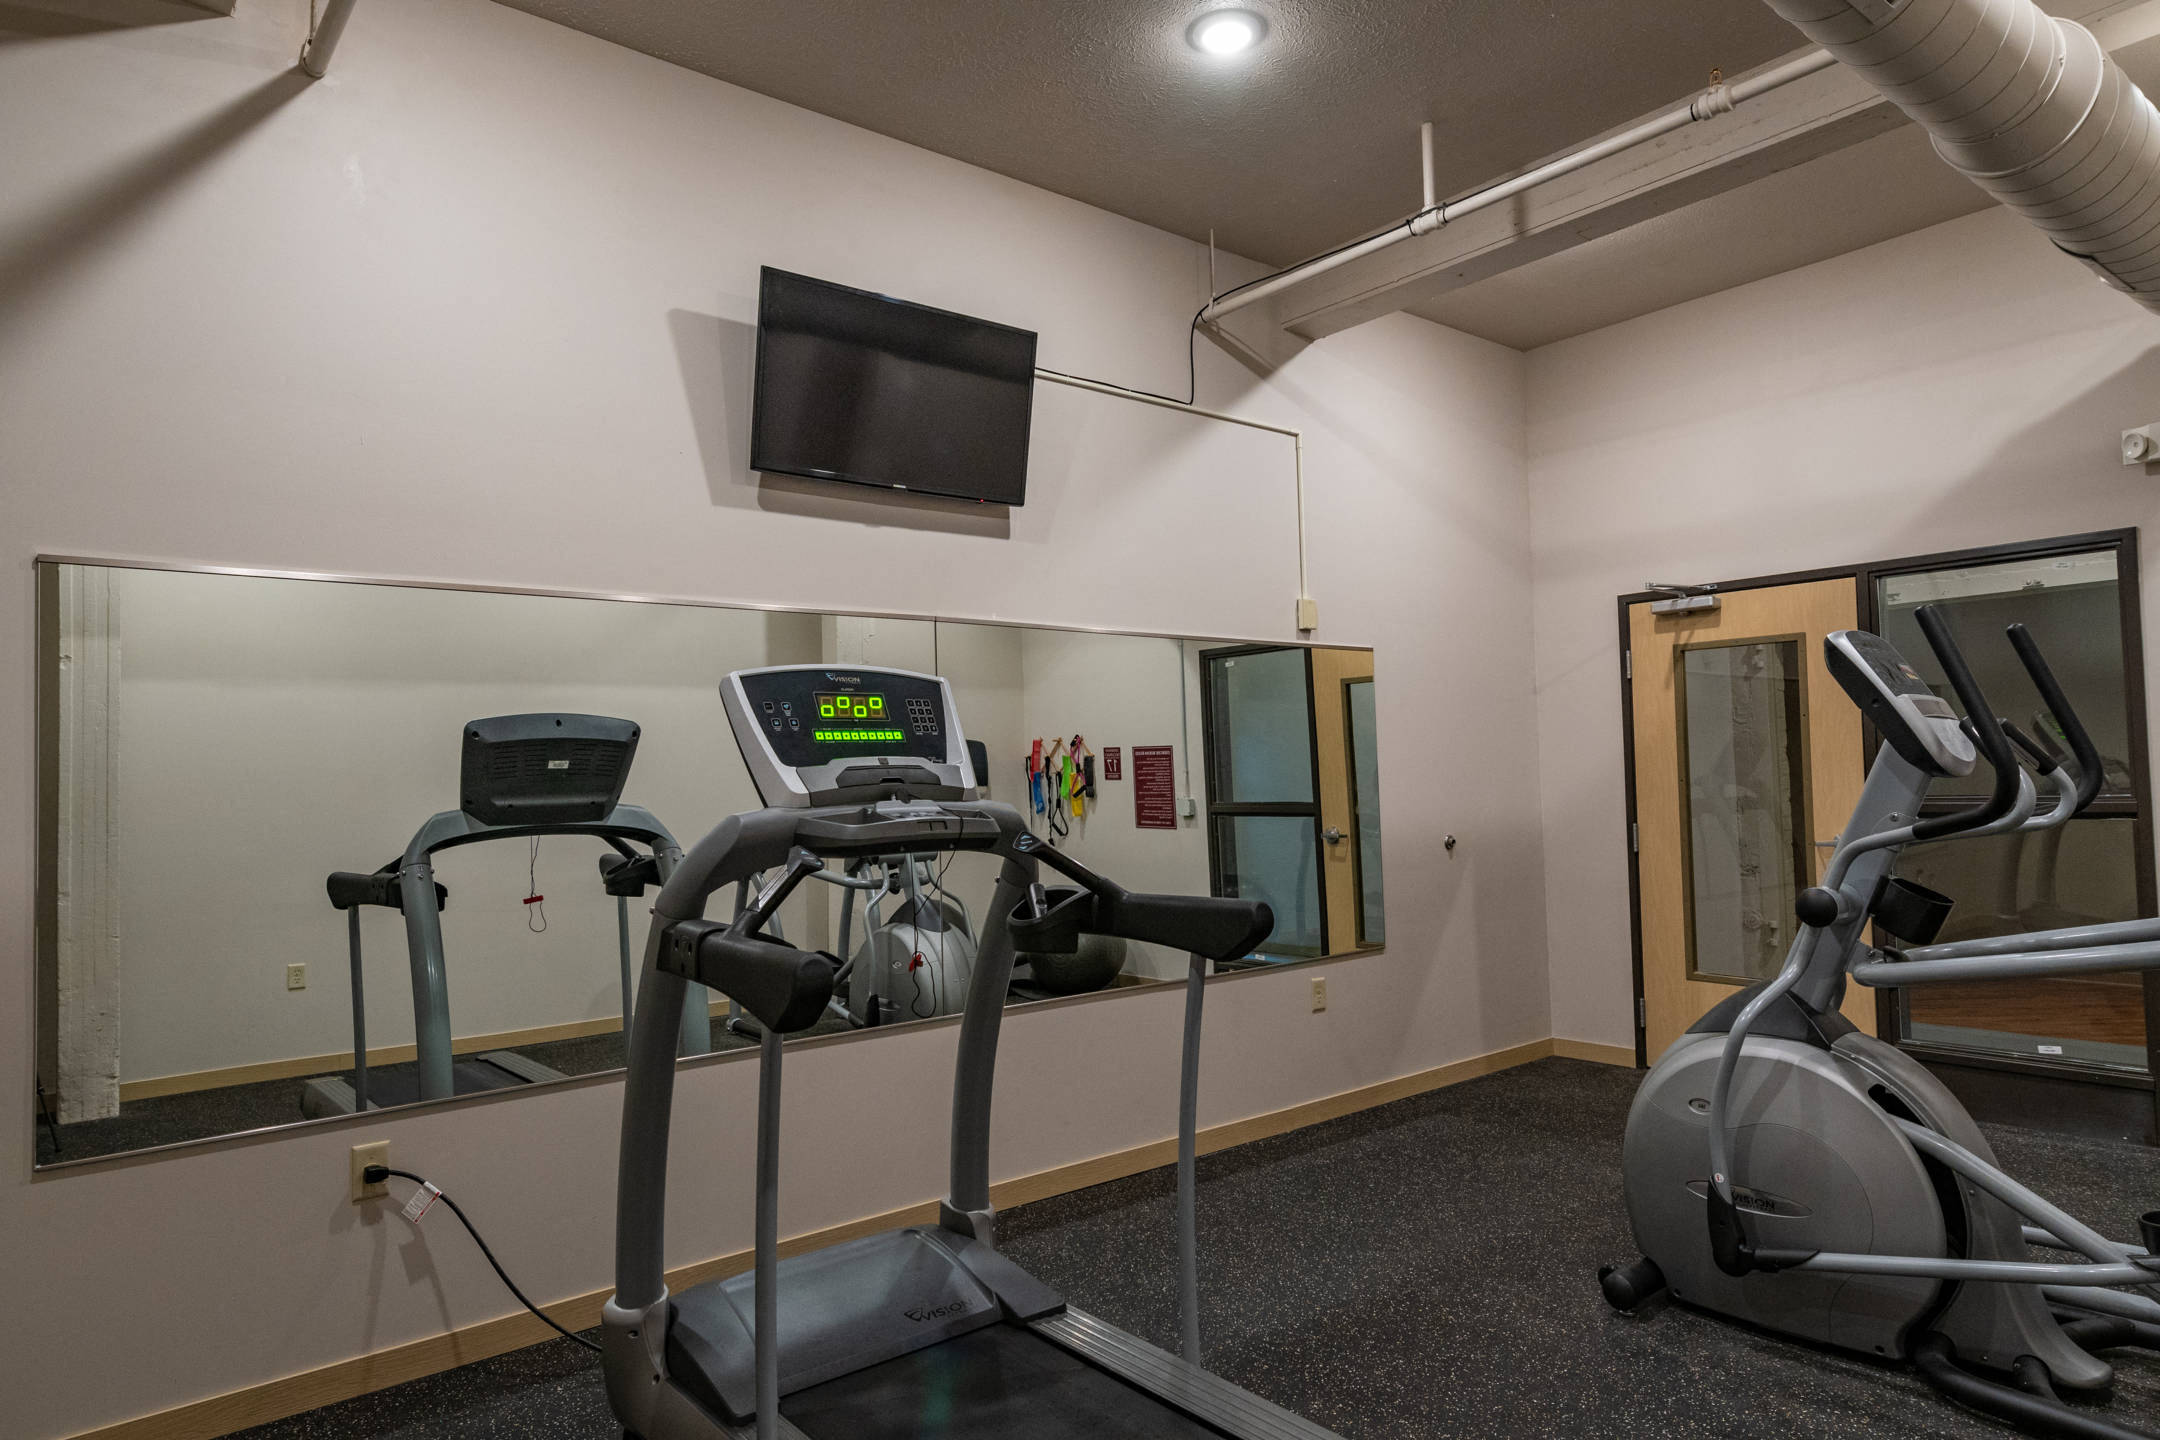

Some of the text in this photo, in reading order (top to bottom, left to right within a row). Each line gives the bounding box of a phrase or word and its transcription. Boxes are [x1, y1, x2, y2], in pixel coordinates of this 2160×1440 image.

[833, 675, 860, 684] VISION
[1731, 1191, 1775, 1209] VISION
[921, 1298, 973, 1321] VISION
